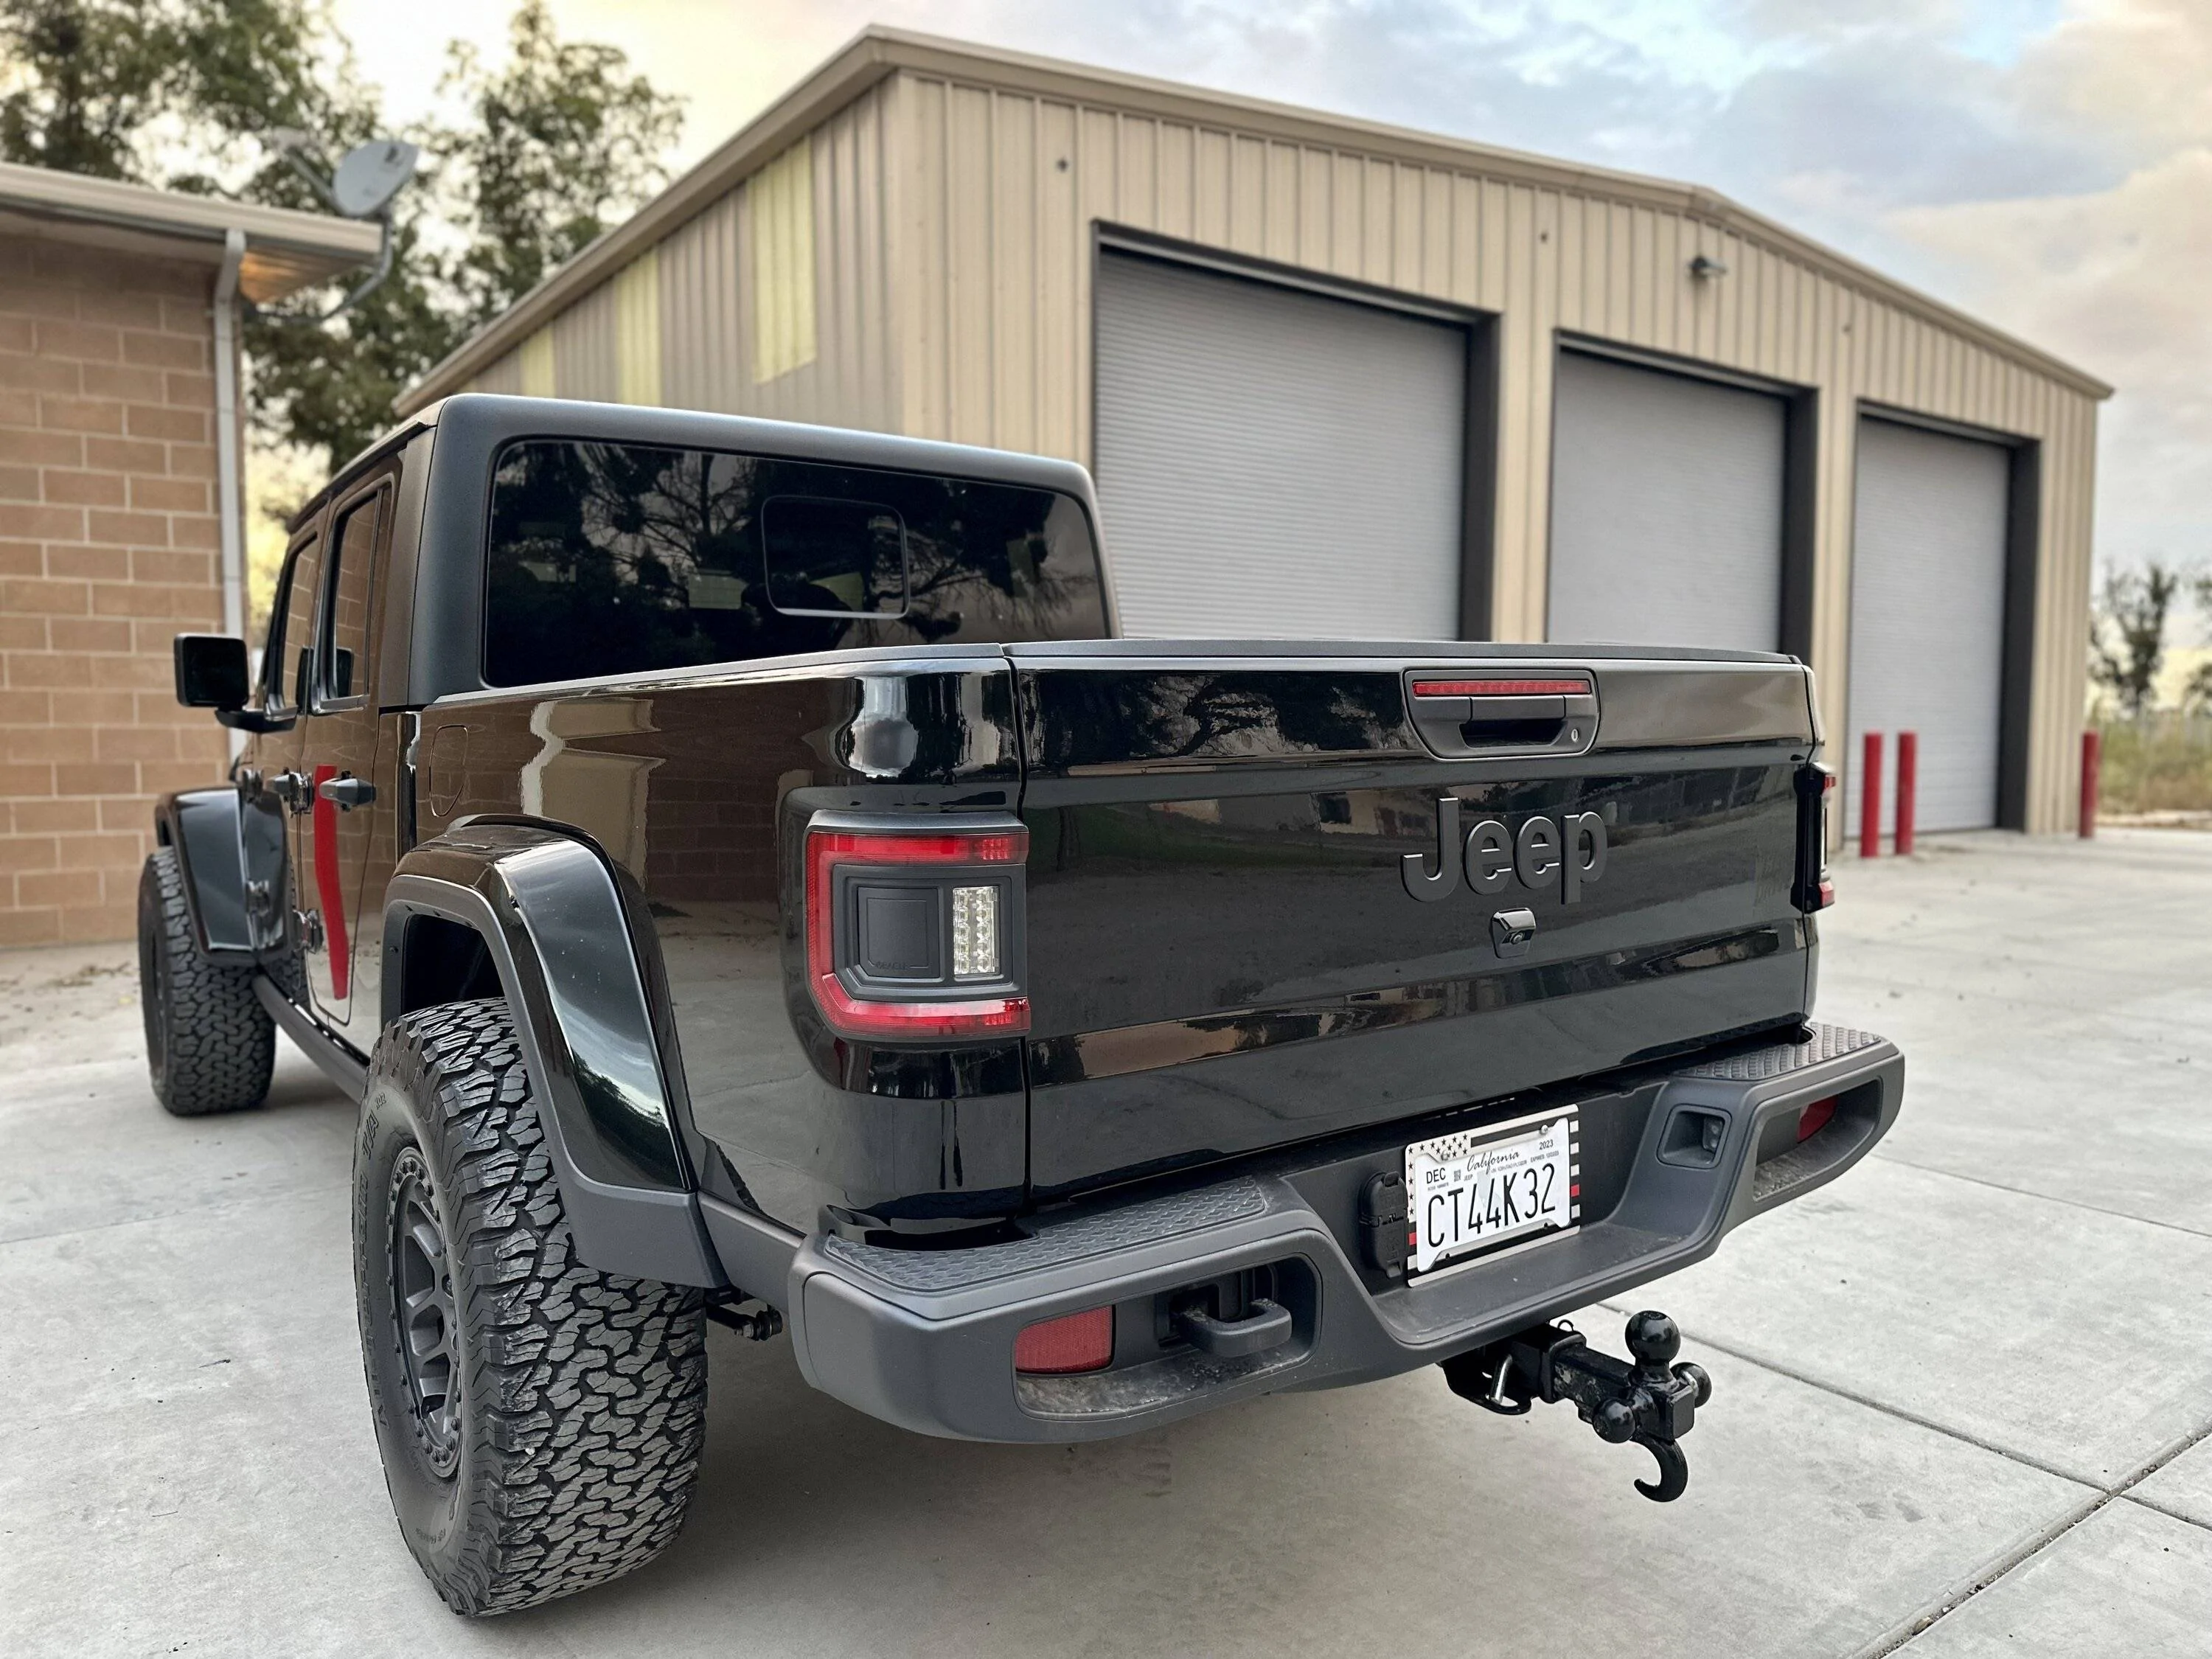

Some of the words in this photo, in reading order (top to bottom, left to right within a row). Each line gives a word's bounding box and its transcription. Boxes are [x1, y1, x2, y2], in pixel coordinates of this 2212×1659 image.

[1401, 797, 1607, 905] Jeep
[1539, 1139, 1554, 1150] 2023
[1467, 1150, 1520, 1175] California
[1426, 1167, 1446, 1184] DEC
[1427, 1162, 1556, 1248] CT44K32
